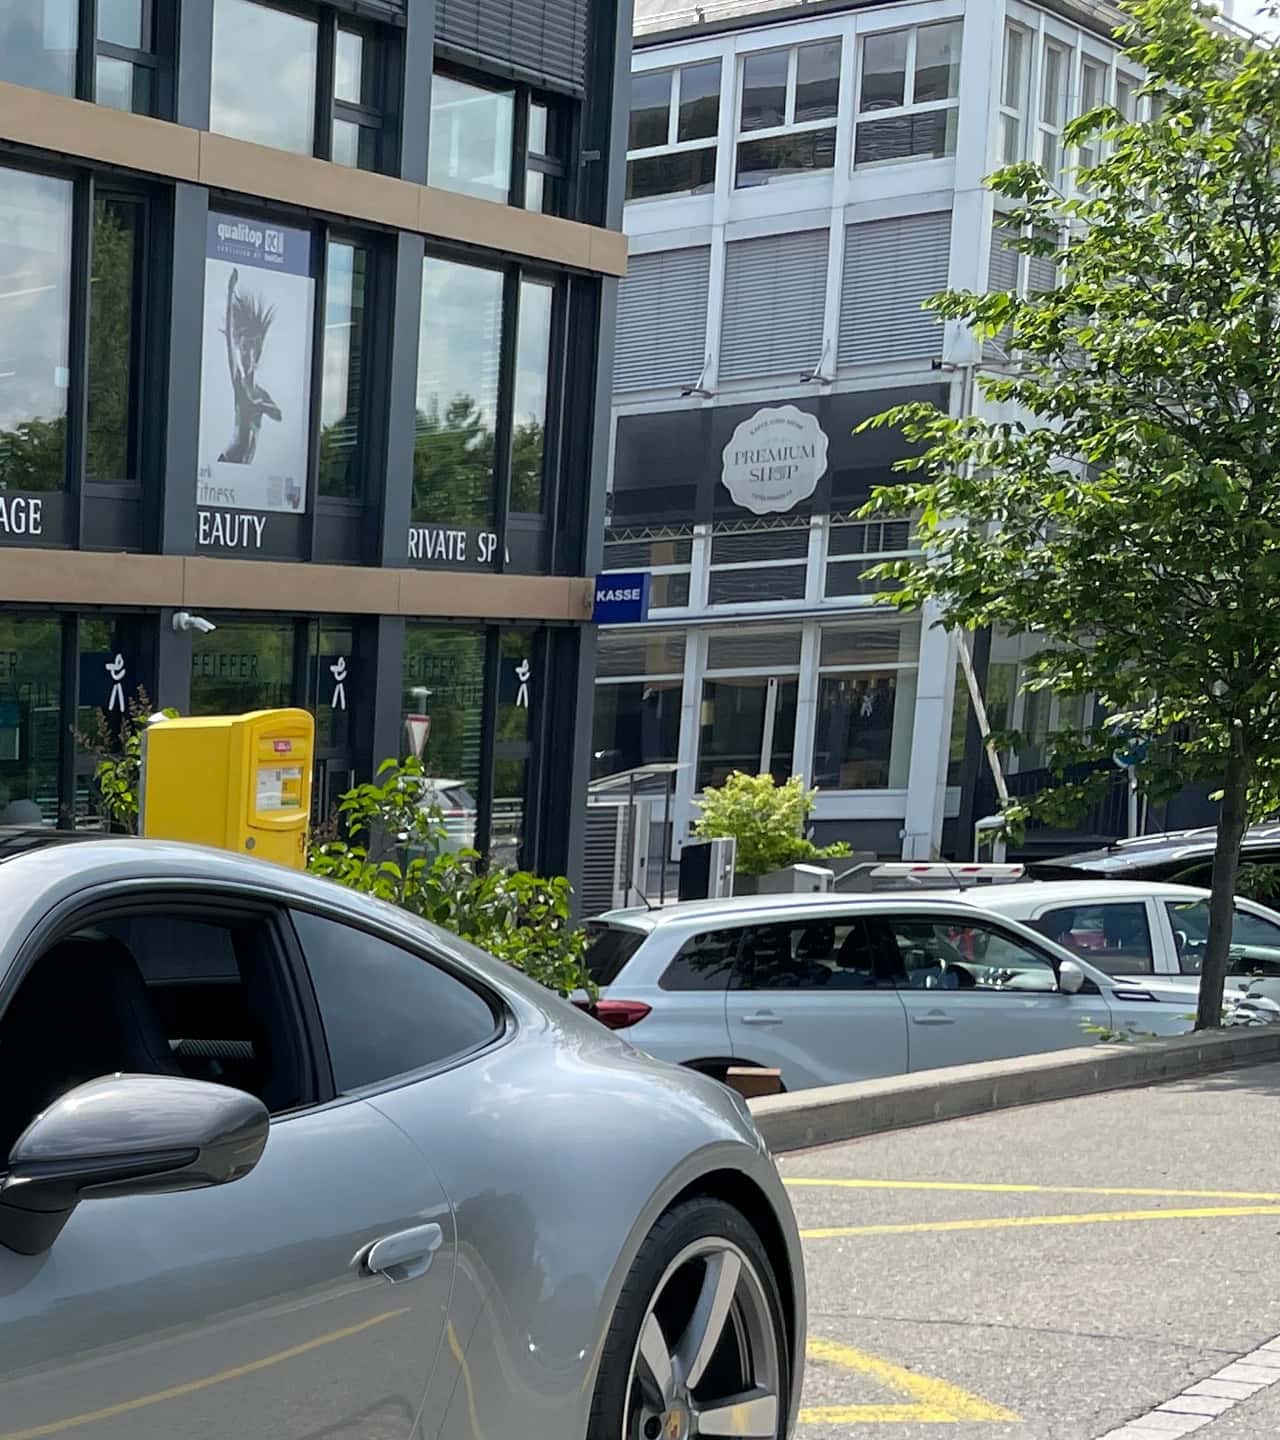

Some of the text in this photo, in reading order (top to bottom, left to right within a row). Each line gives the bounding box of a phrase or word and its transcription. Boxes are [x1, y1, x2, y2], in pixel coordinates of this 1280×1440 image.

[217, 224, 263, 248] qualitop
[735, 443, 816, 465] PREMIUM
[750, 465, 799, 481] SHOP
[198, 512, 267, 548] EAUTY
[407, 528, 510, 563] RIVATE SP
[596, 588, 641, 602] KASSE
